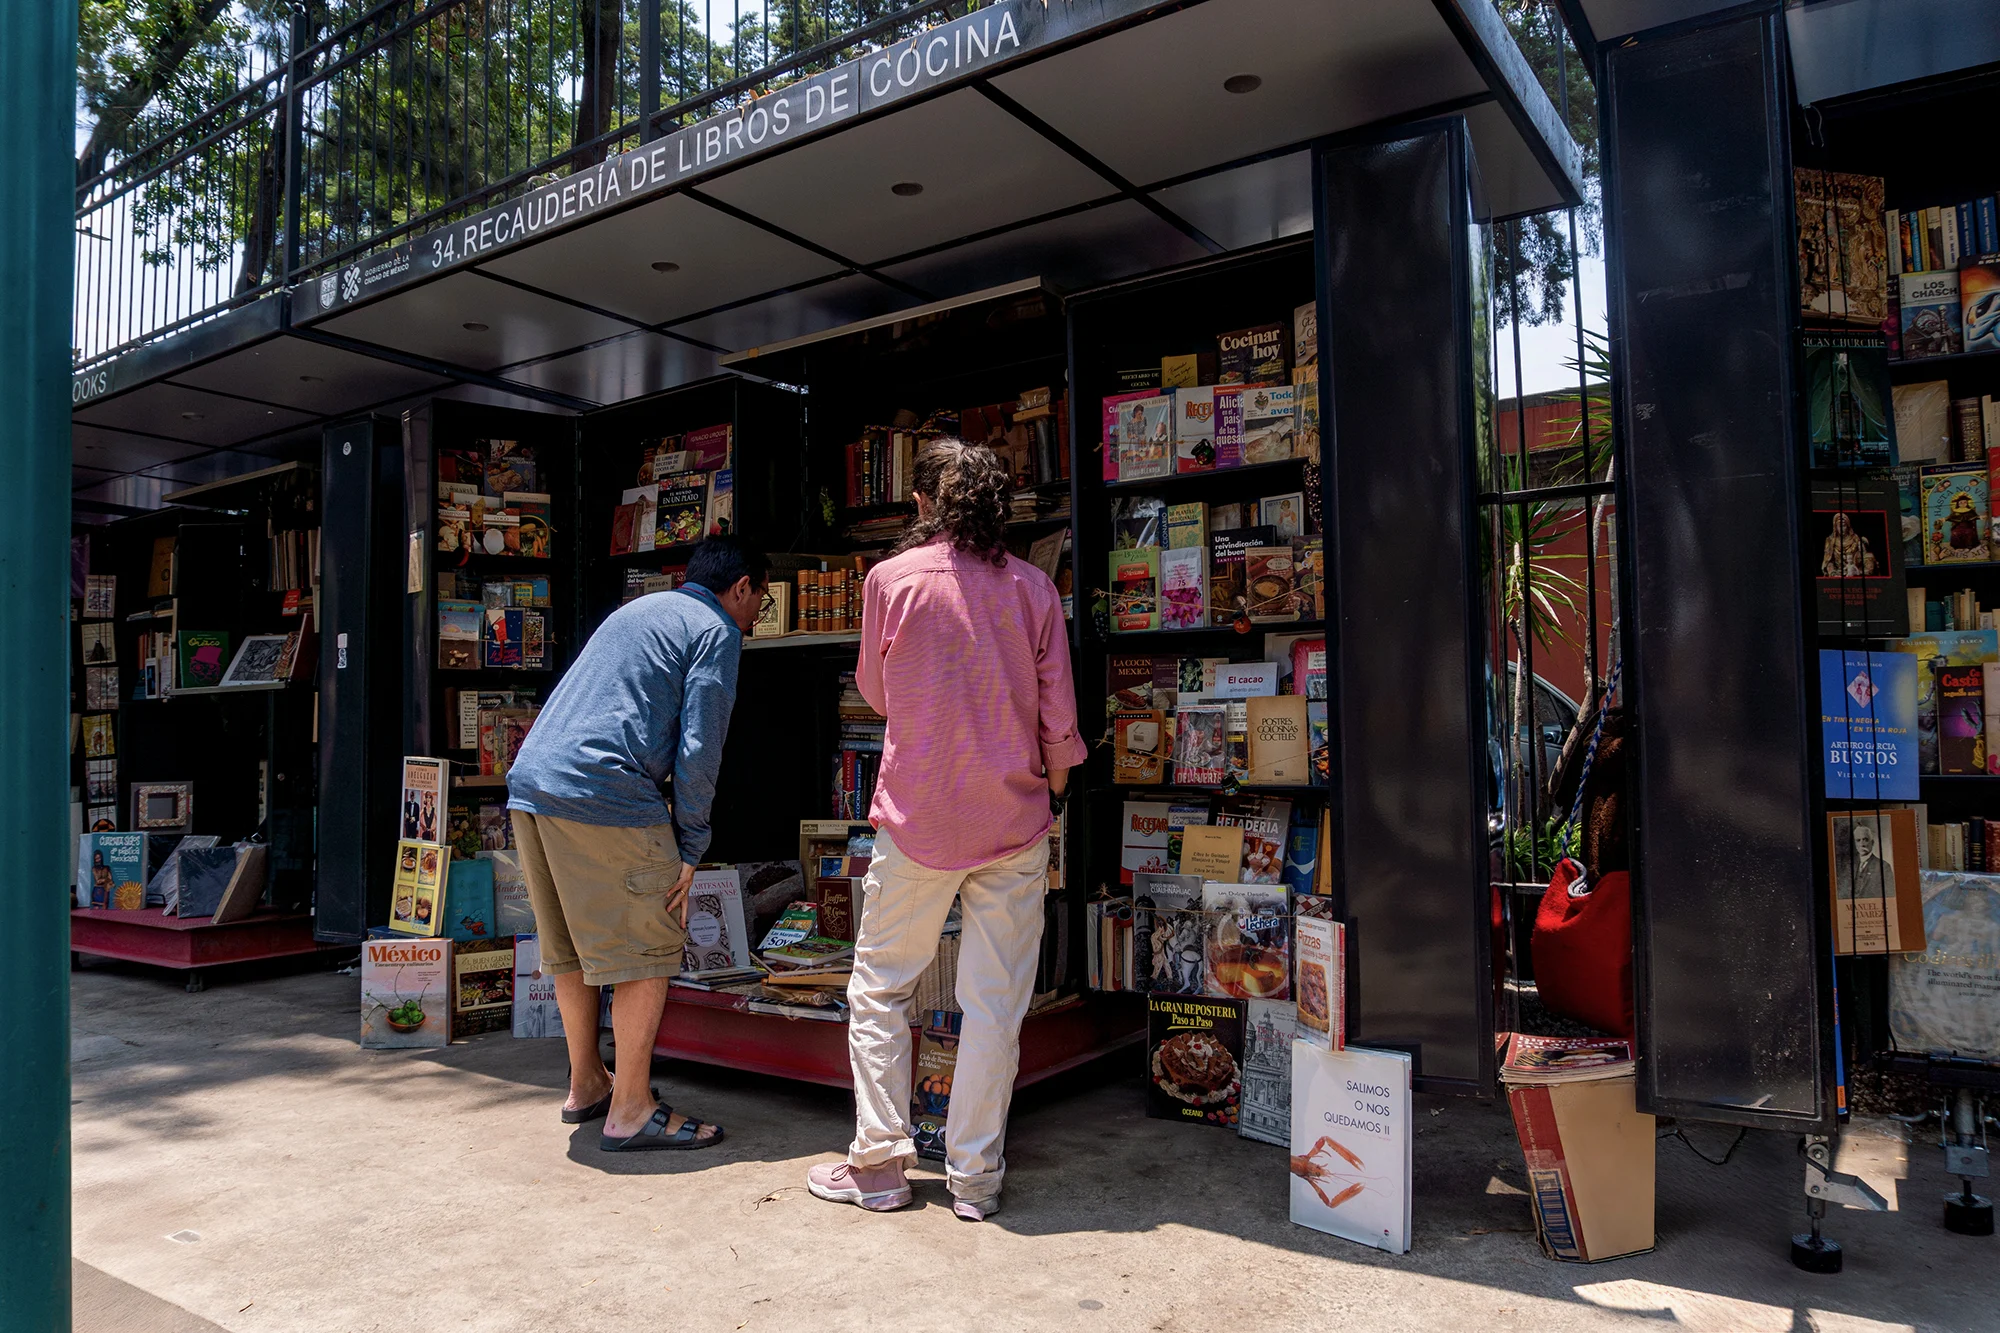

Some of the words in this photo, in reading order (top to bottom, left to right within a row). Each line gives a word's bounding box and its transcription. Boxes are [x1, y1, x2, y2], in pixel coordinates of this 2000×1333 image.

[631, 147, 666, 191] DE
[678, 99, 790, 172] LIBROS
[806, 73, 849, 124] DE
[869, 11, 1020, 97] COCINA
[364, 261, 393, 277] GOBIERNO
[394, 258, 401, 266] DE
[402, 255, 410, 263] LA
[364, 274, 382, 285] CIUDAD
[390, 263, 410, 275] MÉXICO
[1924, 281, 1945, 289] LOS
[1912, 287, 1958, 298] CHASCH
[1220, 329, 1280, 351] Cocinar
[1252, 343, 1281, 361] hoy
[1219, 395, 1244, 409] Alicia
[1223, 412, 1241, 427] país
[1219, 426, 1226, 435] de
[1227, 425, 1236, 434] las
[681, 493, 699, 502] PLATO
[1934, 489, 1954, 516] HASTA
[1956, 485, 1971, 493] NO
[1214, 539, 1263, 550] reivindicación
[1113, 659, 1125, 667] LA
[1228, 676, 1236, 684] El
[1238, 676, 1264, 684] cacao
[1830, 750, 1898, 765] BUSTOS
[1215, 816, 1279, 834] HELADERIA
[694, 881, 734, 890] ARTESANÍA
[1246, 917, 1278, 931] Lechera
[1249, 914, 1258, 922] La
[1298, 930, 1321, 949] Pizzas
[368, 945, 442, 963] México
[472, 957, 490, 965] BUEN
[491, 954, 513, 963] GUSTO
[1926, 969, 1941, 977] The
[1943, 970, 1972, 979] world's
[1975, 973, 1993, 981] most
[1928, 978, 1973, 988] illuminated
[529, 992, 556, 1001] MUN
[1149, 1000, 1159, 1011] LA
[1160, 1001, 1183, 1013] GRAN
[1184, 1003, 1237, 1019] REPOSTERIA
[1171, 1013, 1189, 1025] Paso
[1196, 1016, 1213, 1028] Paso
[1346, 1080, 1390, 1098] SALIMOS
[1181, 1108, 1204, 1118] OCEANO
[1354, 1100, 1363, 1111] O
[1366, 1103, 1390, 1117] NOS
[1324, 1111, 1381, 1134] QUEDAMOS
[1384, 1125, 1390, 1135] II
